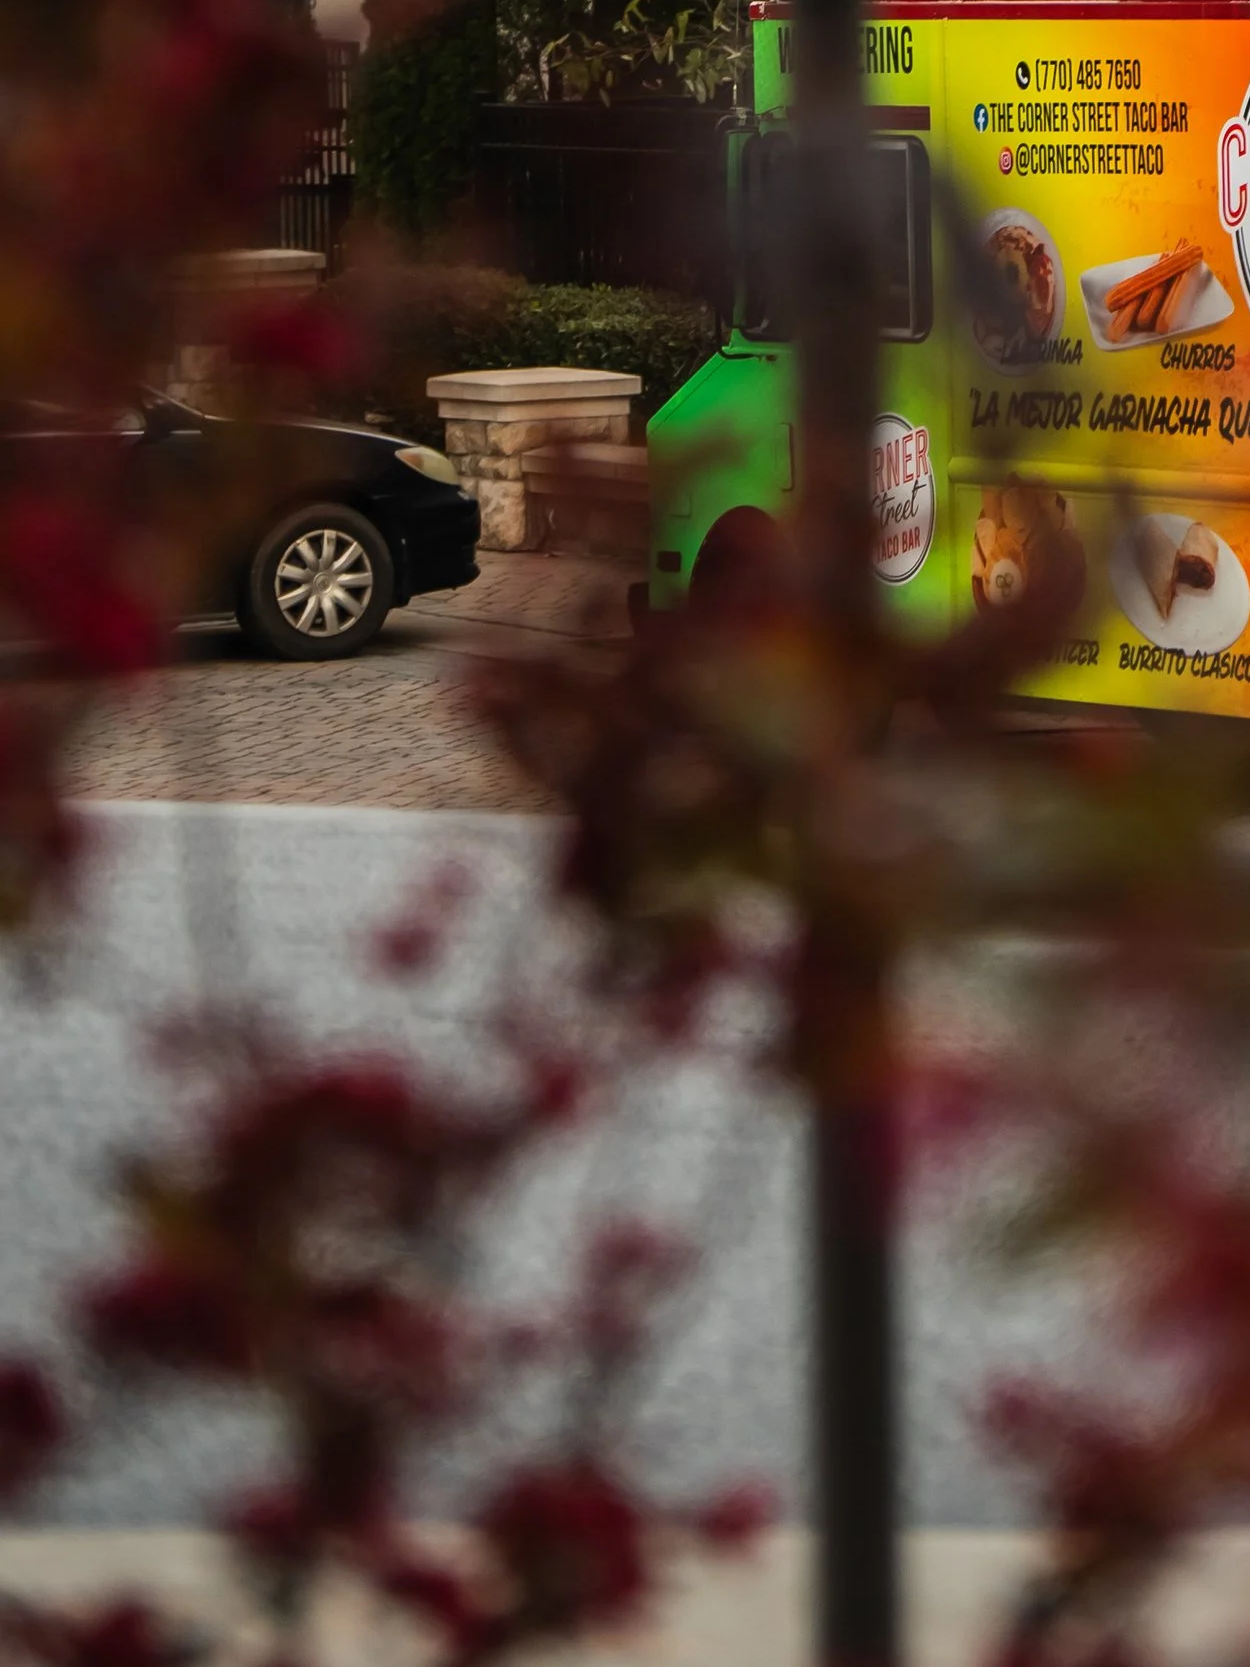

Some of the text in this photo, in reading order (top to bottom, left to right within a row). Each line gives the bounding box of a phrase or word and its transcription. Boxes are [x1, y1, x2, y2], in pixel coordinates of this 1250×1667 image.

[1035, 58, 1141, 92] (770) 485 7650
[989, 102, 1189, 133] THE CORNER STREET TACO BAR
[1015, 142, 1164, 176] @CORNERSTREETTACO
[1160, 343, 1236, 372] CHURROS
[1005, 391, 1081, 431] MEJOR
[1088, 394, 1211, 437] GARNACHA
[872, 428, 930, 495] RNER
[901, 526, 921, 554] BAR
[1119, 642, 1187, 676] BURRITO
